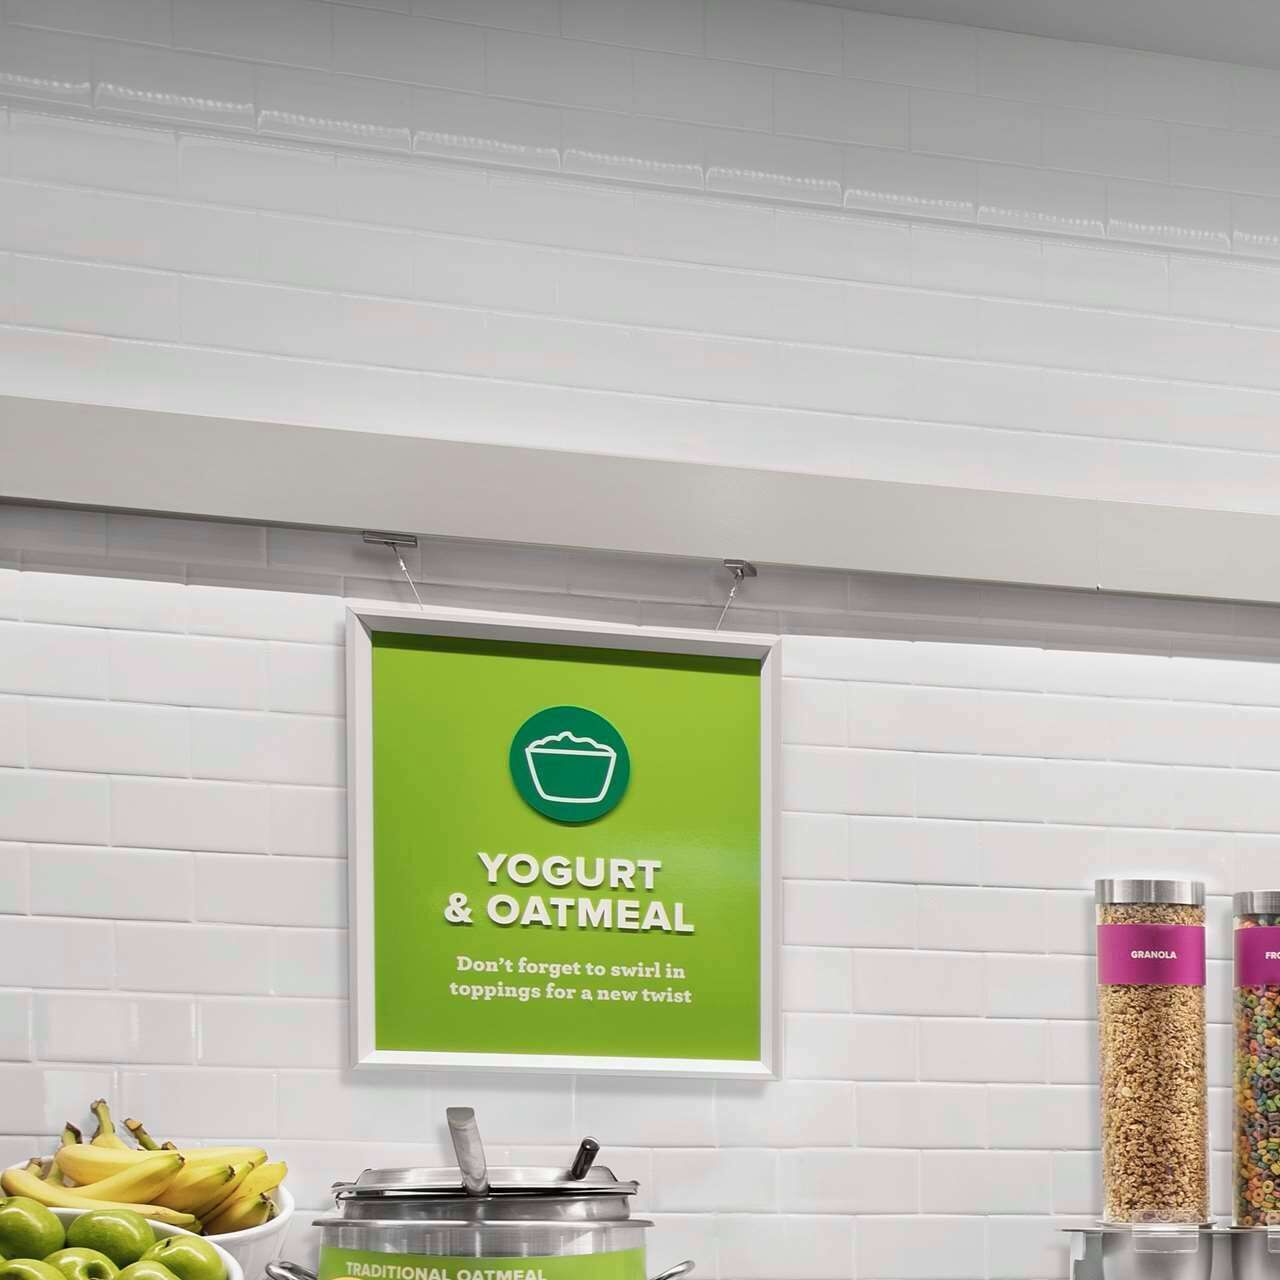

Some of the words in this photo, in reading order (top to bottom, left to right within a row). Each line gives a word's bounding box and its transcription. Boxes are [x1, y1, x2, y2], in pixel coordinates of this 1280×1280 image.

[478, 852, 661, 889] YOGURT
[444, 892, 473, 924] &
[487, 893, 695, 933] OATMEAL
[1131, 950, 1177, 959] GRANOLA
[456, 955, 513, 973] Don't
[518, 957, 581, 978] forget
[585, 961, 606, 976] to
[610, 961, 661, 978] swirl
[665, 963, 686, 979] in
[449, 981, 541, 1002] toppings
[545, 982, 577, 1000] for
[581, 987, 593, 1001] a
[596, 987, 638, 1001] new
[641, 986, 693, 1004] twist
